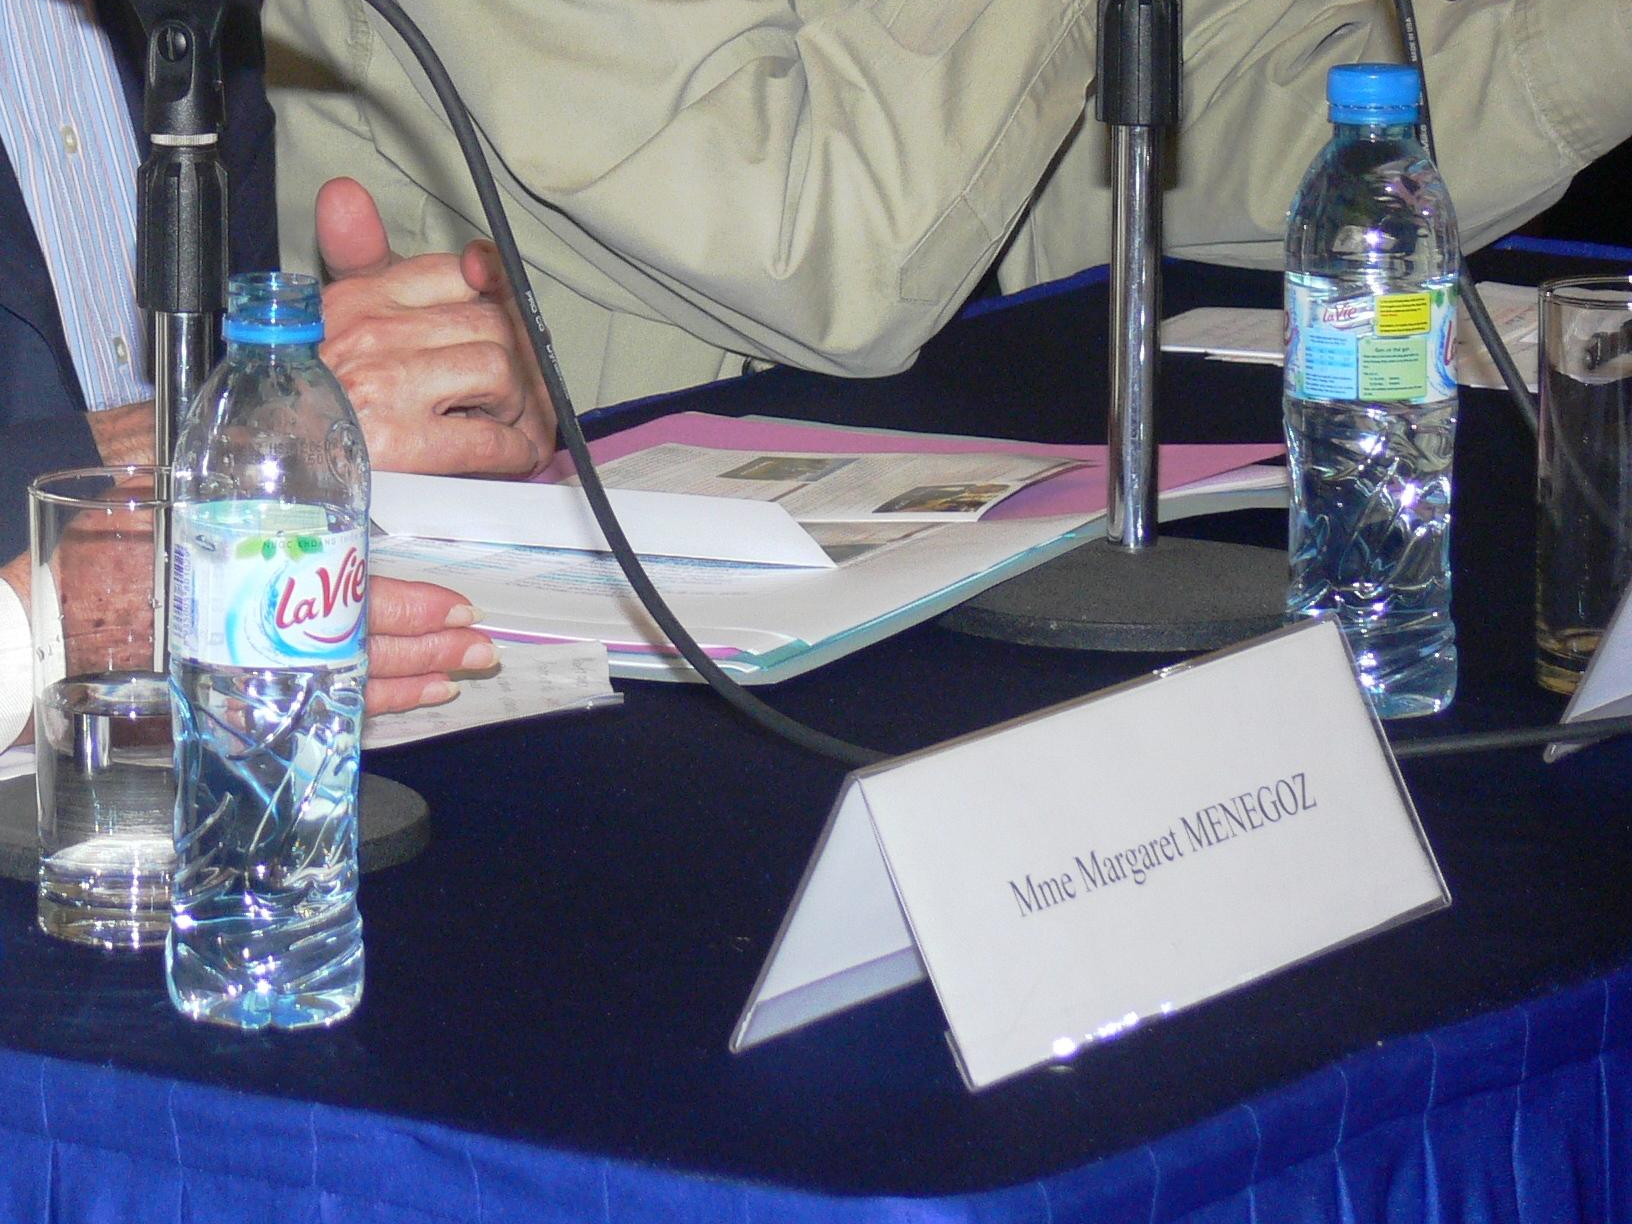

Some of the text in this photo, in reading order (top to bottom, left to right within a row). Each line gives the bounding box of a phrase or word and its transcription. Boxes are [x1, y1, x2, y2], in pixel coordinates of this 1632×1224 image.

[1008, 772, 1318, 917] Mme Margaret MENEGOZ
